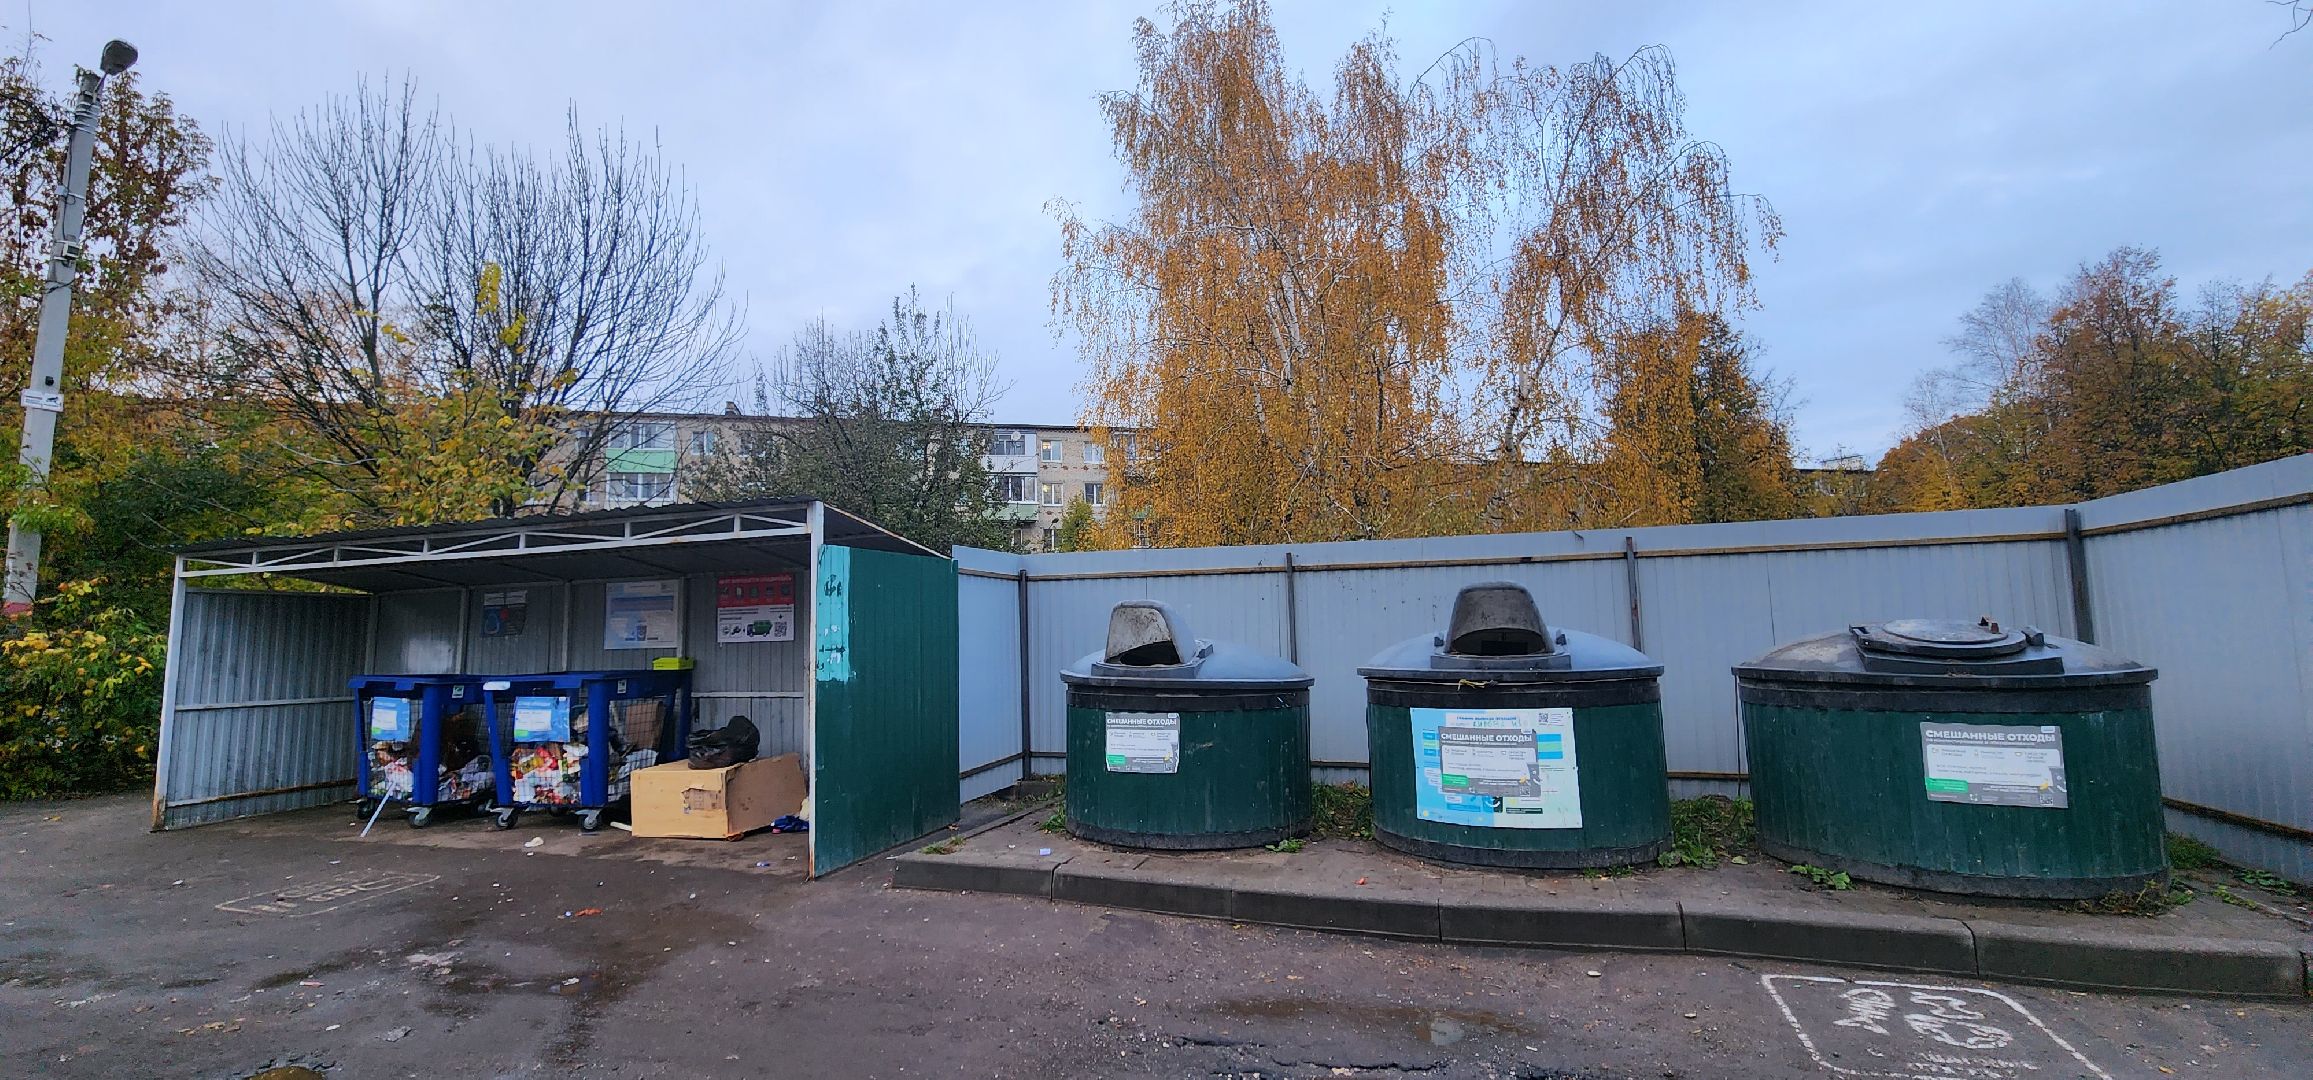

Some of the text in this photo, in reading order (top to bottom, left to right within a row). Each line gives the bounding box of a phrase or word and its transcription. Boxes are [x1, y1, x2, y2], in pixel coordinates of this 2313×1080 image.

[1147, 718, 1177, 726] ОТХОДЫ
[1441, 733, 1495, 743] СМЕШАННЫЕ
[1495, 734, 1532, 743] ОТХОДЫ
[1925, 729, 2005, 741] СМЕШАННЫЕ
[2006, 733, 2056, 743] ОТХОДЫ
